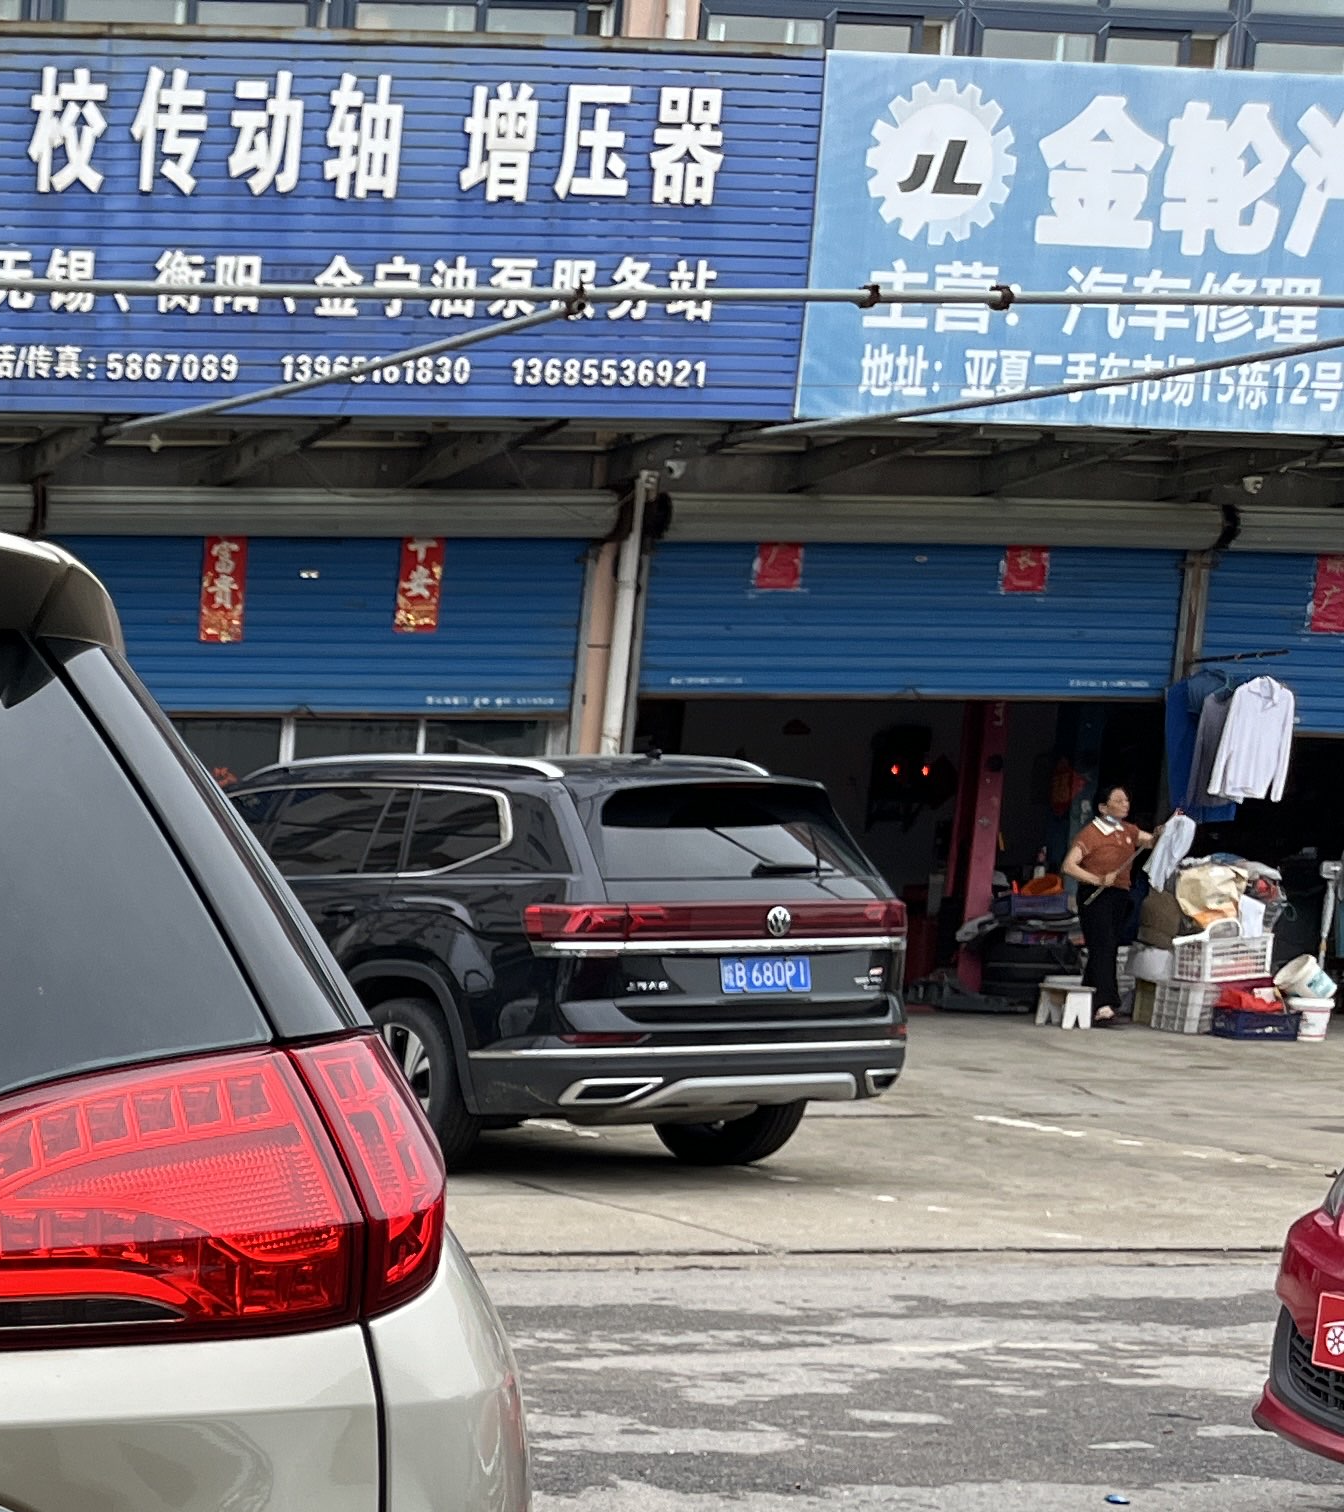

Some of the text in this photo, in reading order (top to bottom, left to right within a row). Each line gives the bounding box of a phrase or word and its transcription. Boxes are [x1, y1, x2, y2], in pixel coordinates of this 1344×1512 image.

[26, 65, 405, 200] 校传动轴
[459, 81, 725, 206] 增压器
[897, 139, 983, 196] JL
[512, 358, 707, 388] 13685536921
